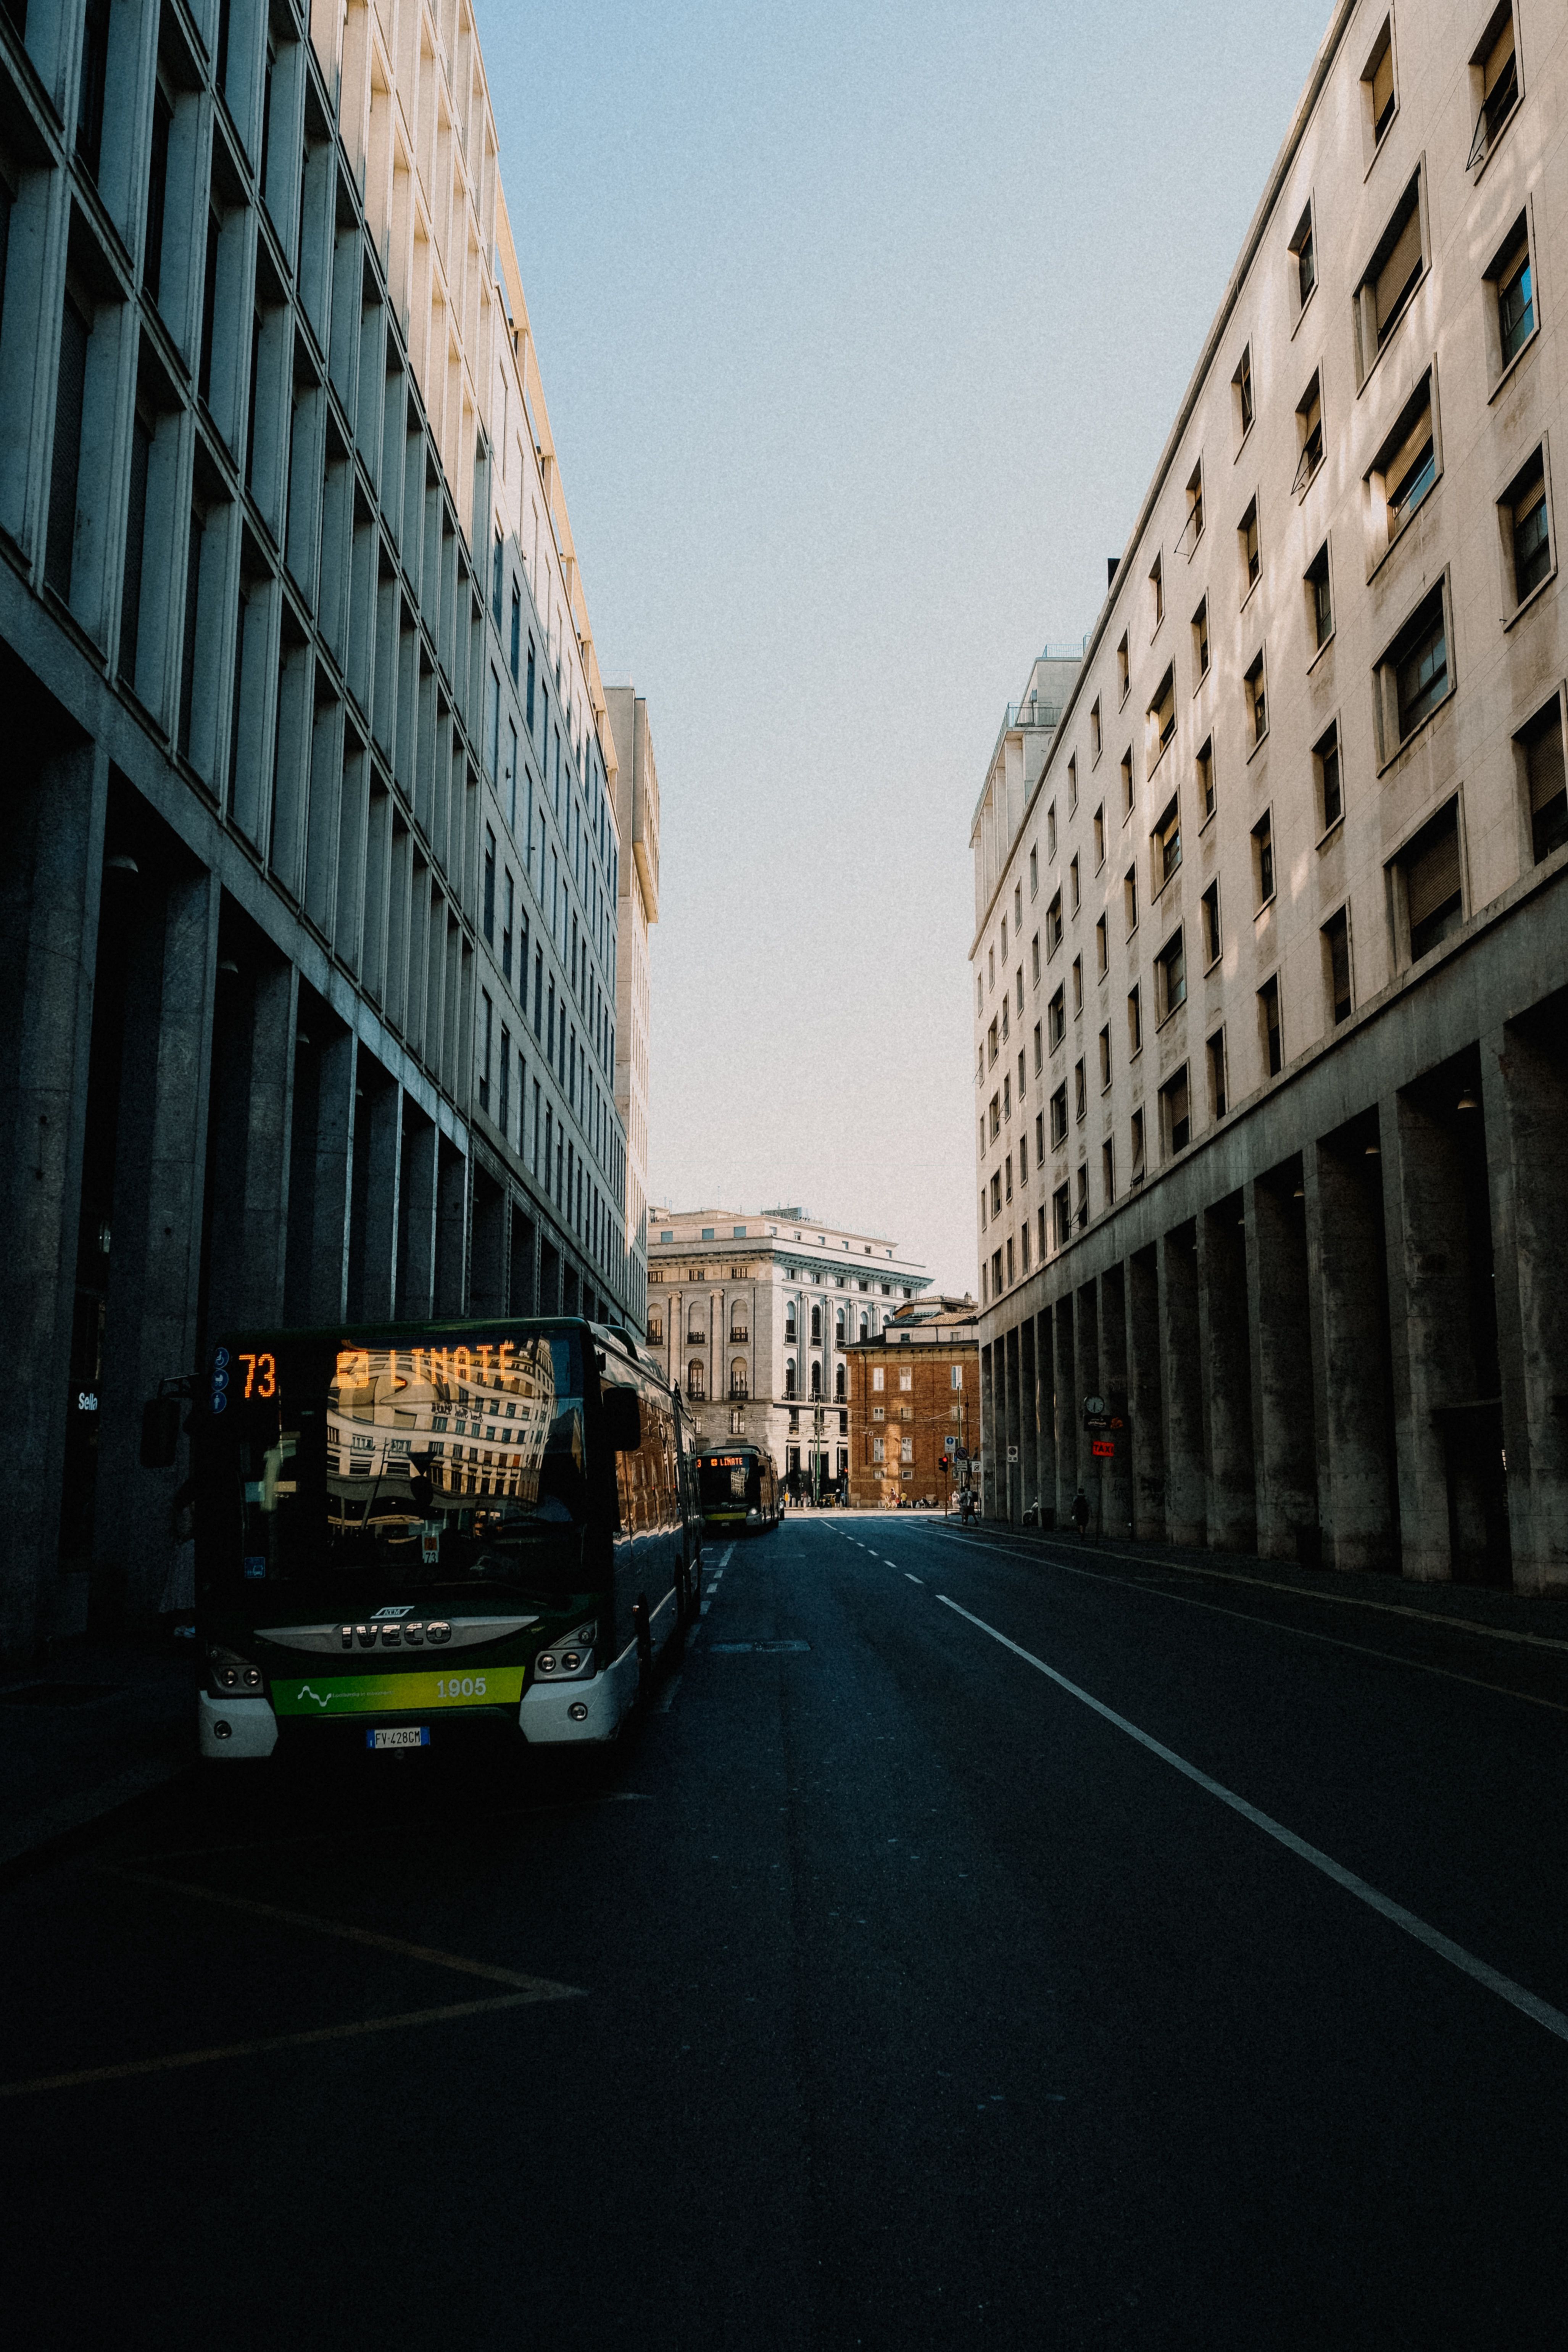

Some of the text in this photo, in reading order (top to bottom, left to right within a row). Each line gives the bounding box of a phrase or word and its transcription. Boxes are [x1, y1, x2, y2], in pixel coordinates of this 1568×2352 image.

[239, 1344, 515, 1398] 73 LINATE
[78, 1392, 97, 1411] Sella
[1093, 1445, 1114, 1453] TAXI
[720, 1457, 743, 1466] LINATE
[425, 1552, 436, 1563] 73
[342, 1622, 451, 1649] IVECO
[437, 1677, 486, 1698] 1905
